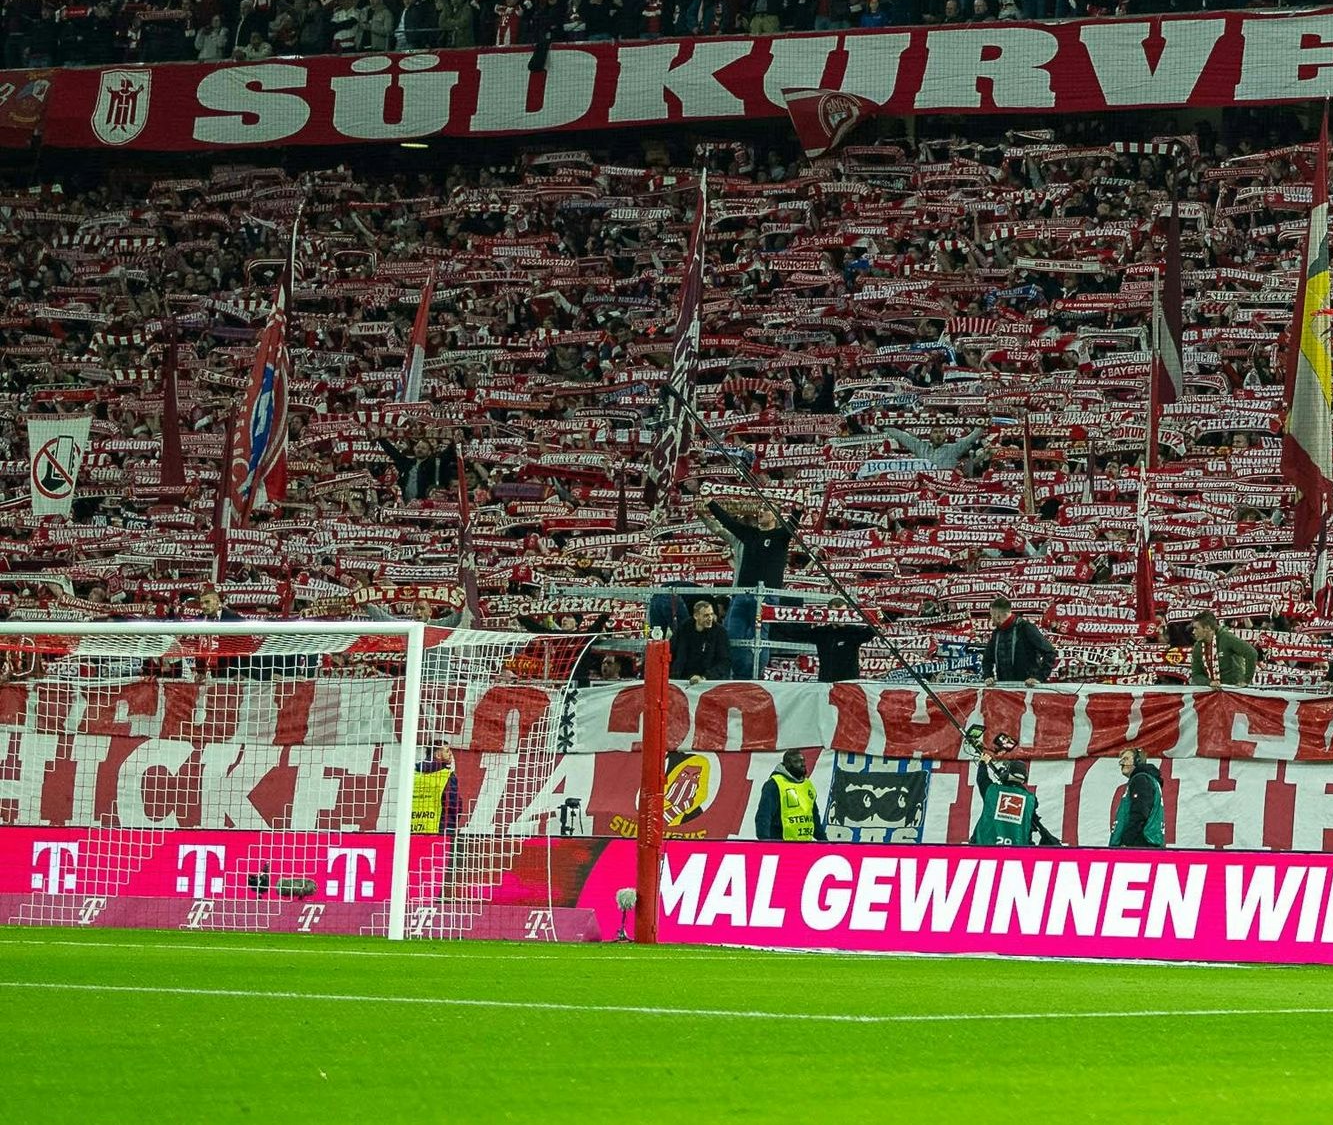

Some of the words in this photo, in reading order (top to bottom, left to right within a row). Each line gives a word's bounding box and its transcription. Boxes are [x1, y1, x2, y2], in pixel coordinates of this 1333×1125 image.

[699, 482, 806, 505] SCHICKERIA
[1172, 482, 1193, 490] SIND
[1195, 482, 1235, 490] MÜNCHEN
[1065, 504, 1132, 519] SÜDKURVE
[937, 530, 1006, 544] SÜDKURVE
[510, 598, 617, 618] SCHICKERIA
[1055, 604, 1137, 622] SÜDKURVE
[1075, 624, 1139, 634] SÜDKURVE
[660, 853, 787, 928] MAL
[801, 855, 1207, 940] GEWINNEN
